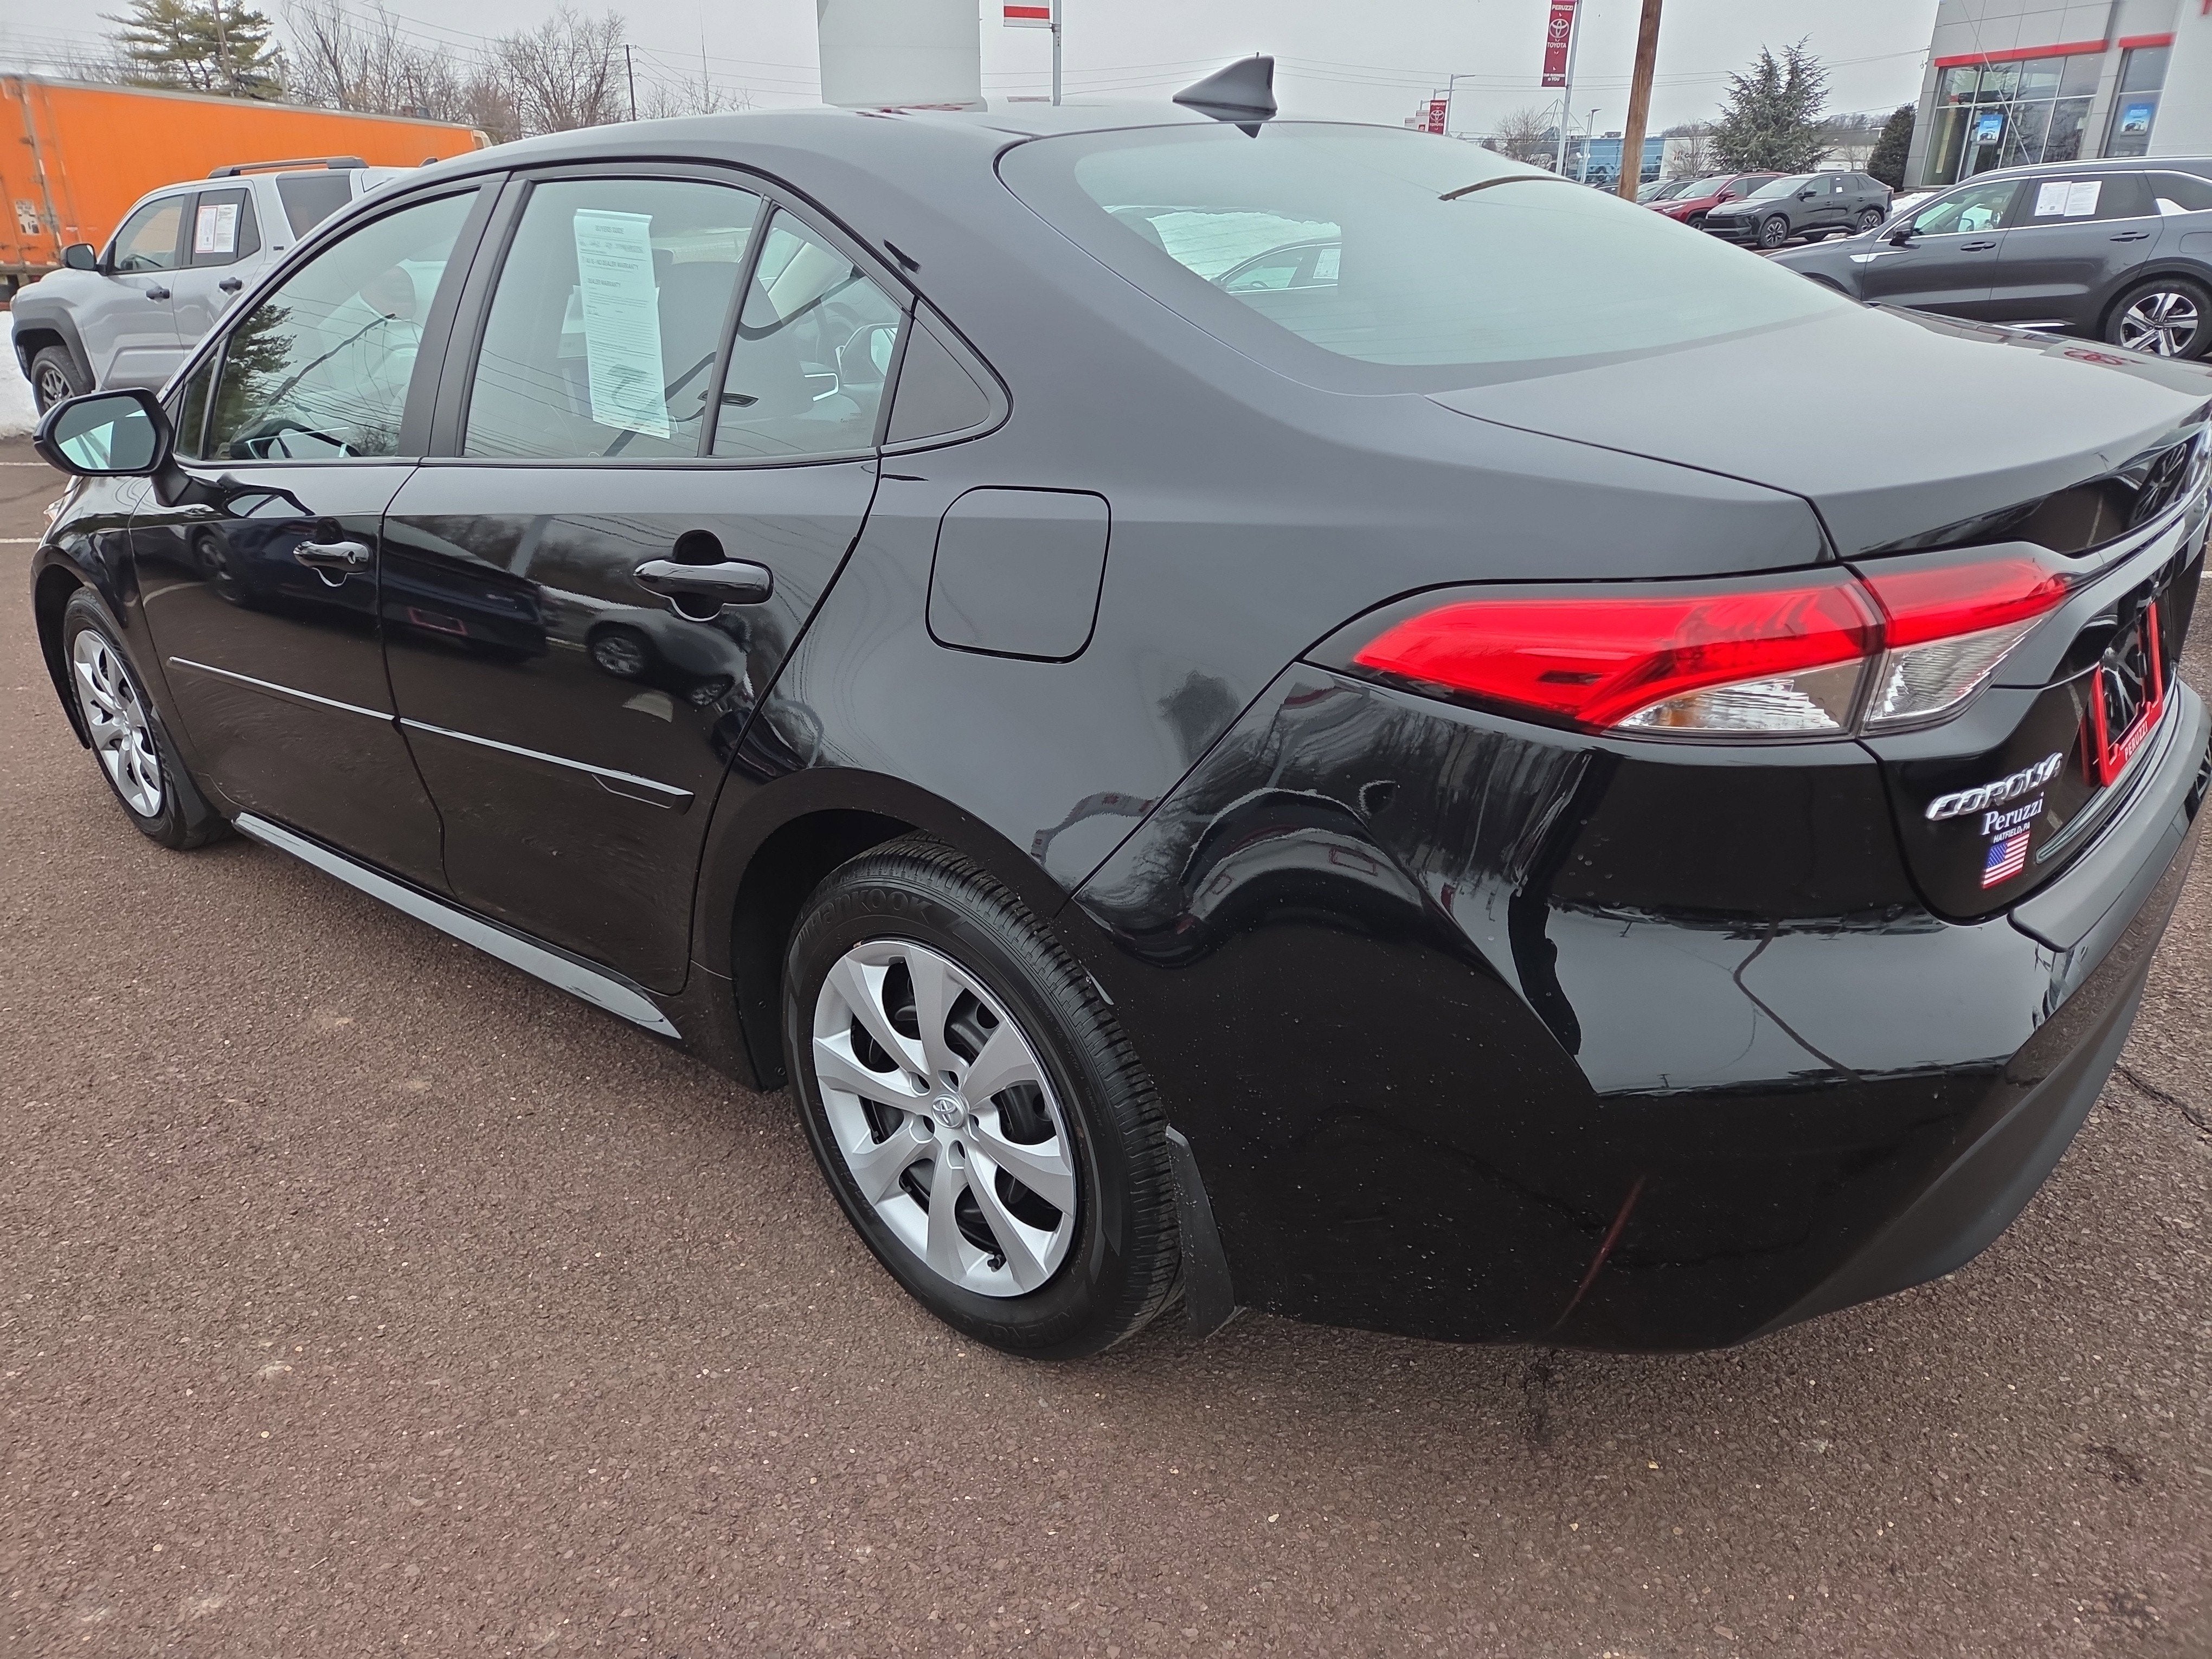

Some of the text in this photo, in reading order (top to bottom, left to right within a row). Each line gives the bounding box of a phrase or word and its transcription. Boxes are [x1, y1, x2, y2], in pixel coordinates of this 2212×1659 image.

[2124, 720, 2148, 761] PERUZZI
[1925, 752, 2062, 820] COROLLA
[1982, 791, 2044, 835] Peruzzi
[1993, 821, 2030, 844] HATFIELD, PA
